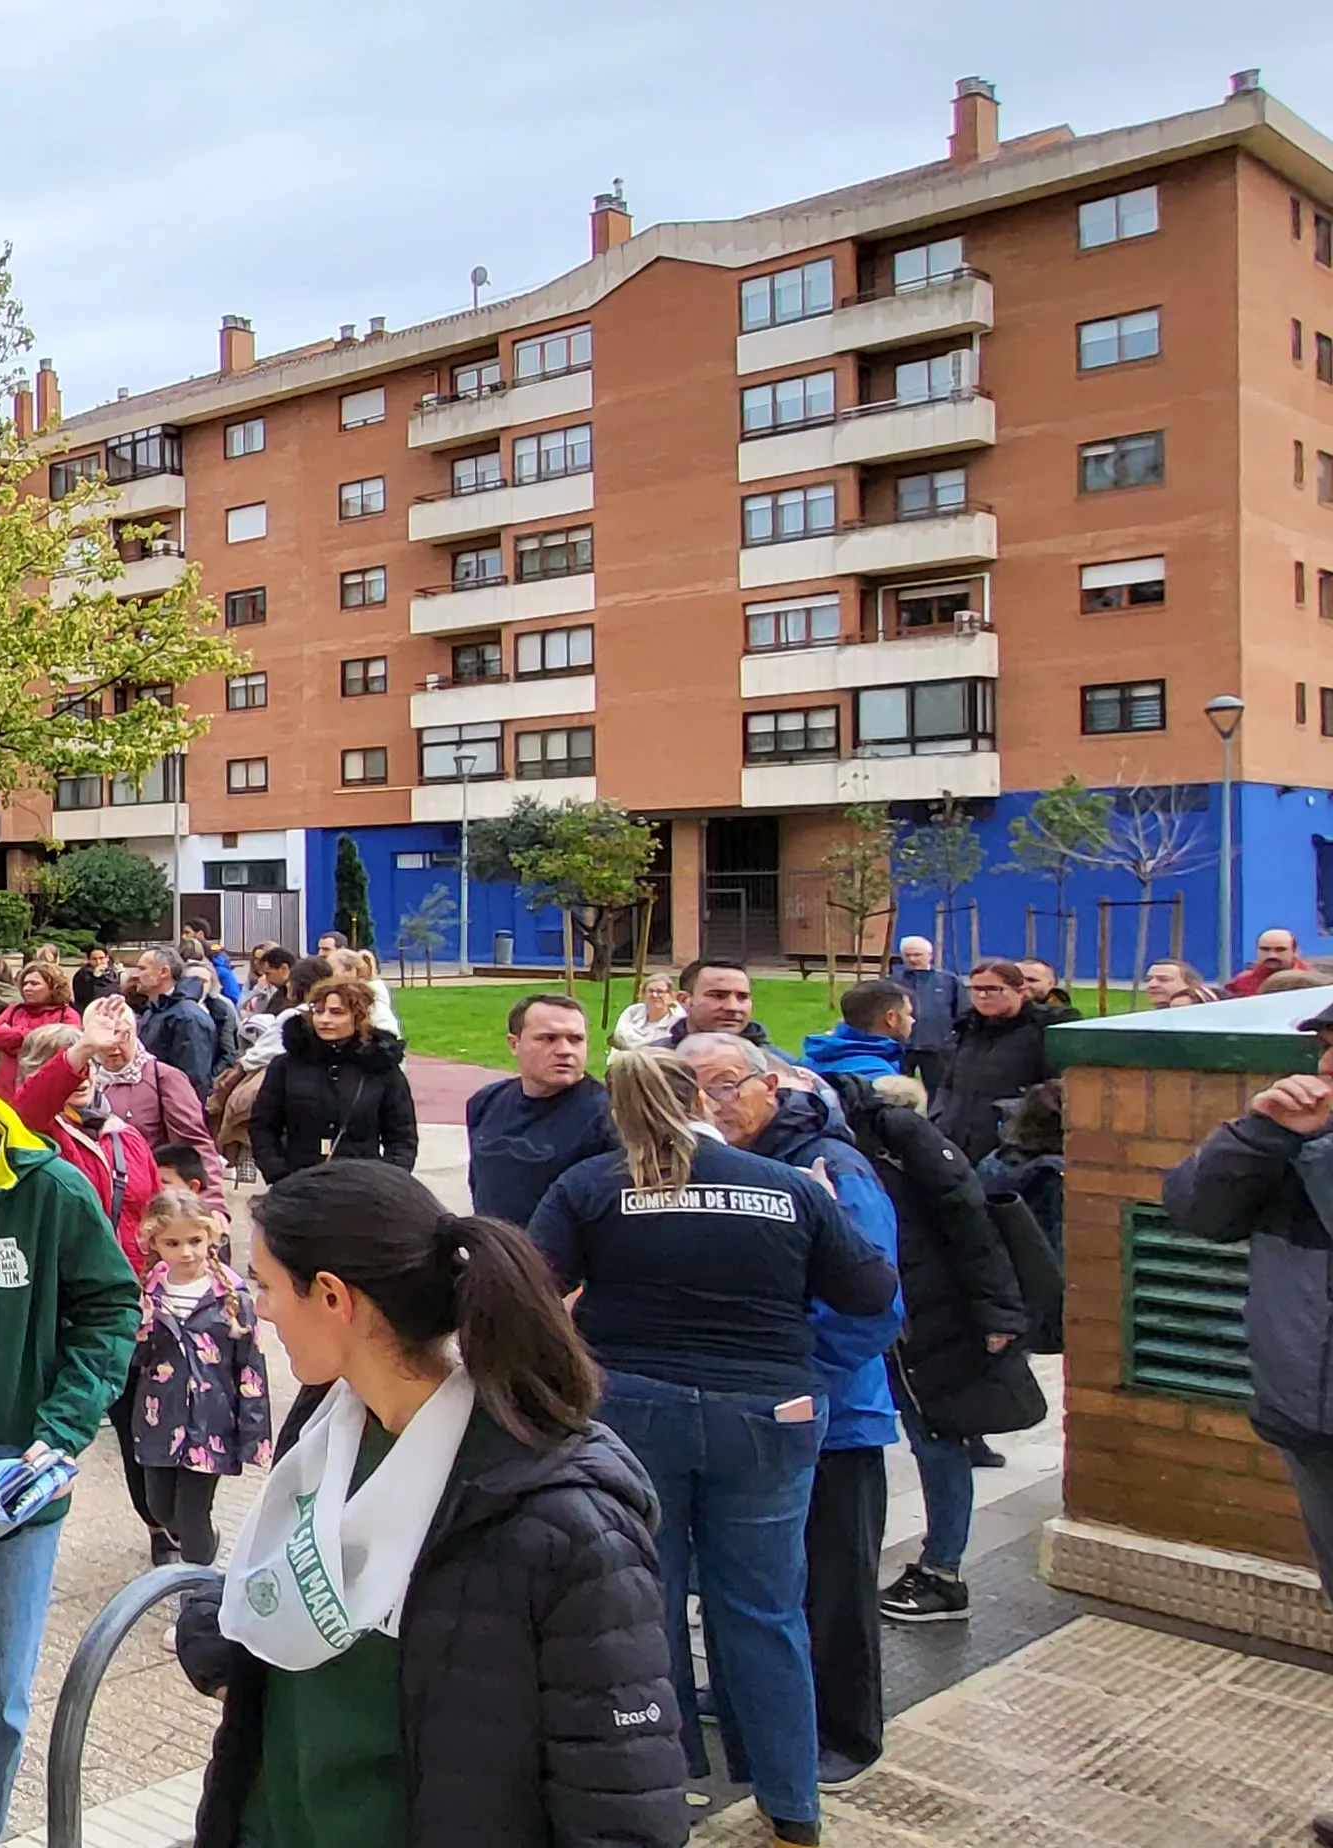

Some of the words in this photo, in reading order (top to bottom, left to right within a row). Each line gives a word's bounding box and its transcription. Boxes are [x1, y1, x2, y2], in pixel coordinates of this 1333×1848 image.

[705, 1191, 725, 1208] DE
[729, 1191, 789, 1216] FIESTAS
[0, 1249, 17, 1260] SAN
[2, 1260, 18, 1270] MAR
[2, 1271, 20, 1285] TIN
[288, 1527, 319, 1575] SAN
[613, 1709, 647, 1726] izas
